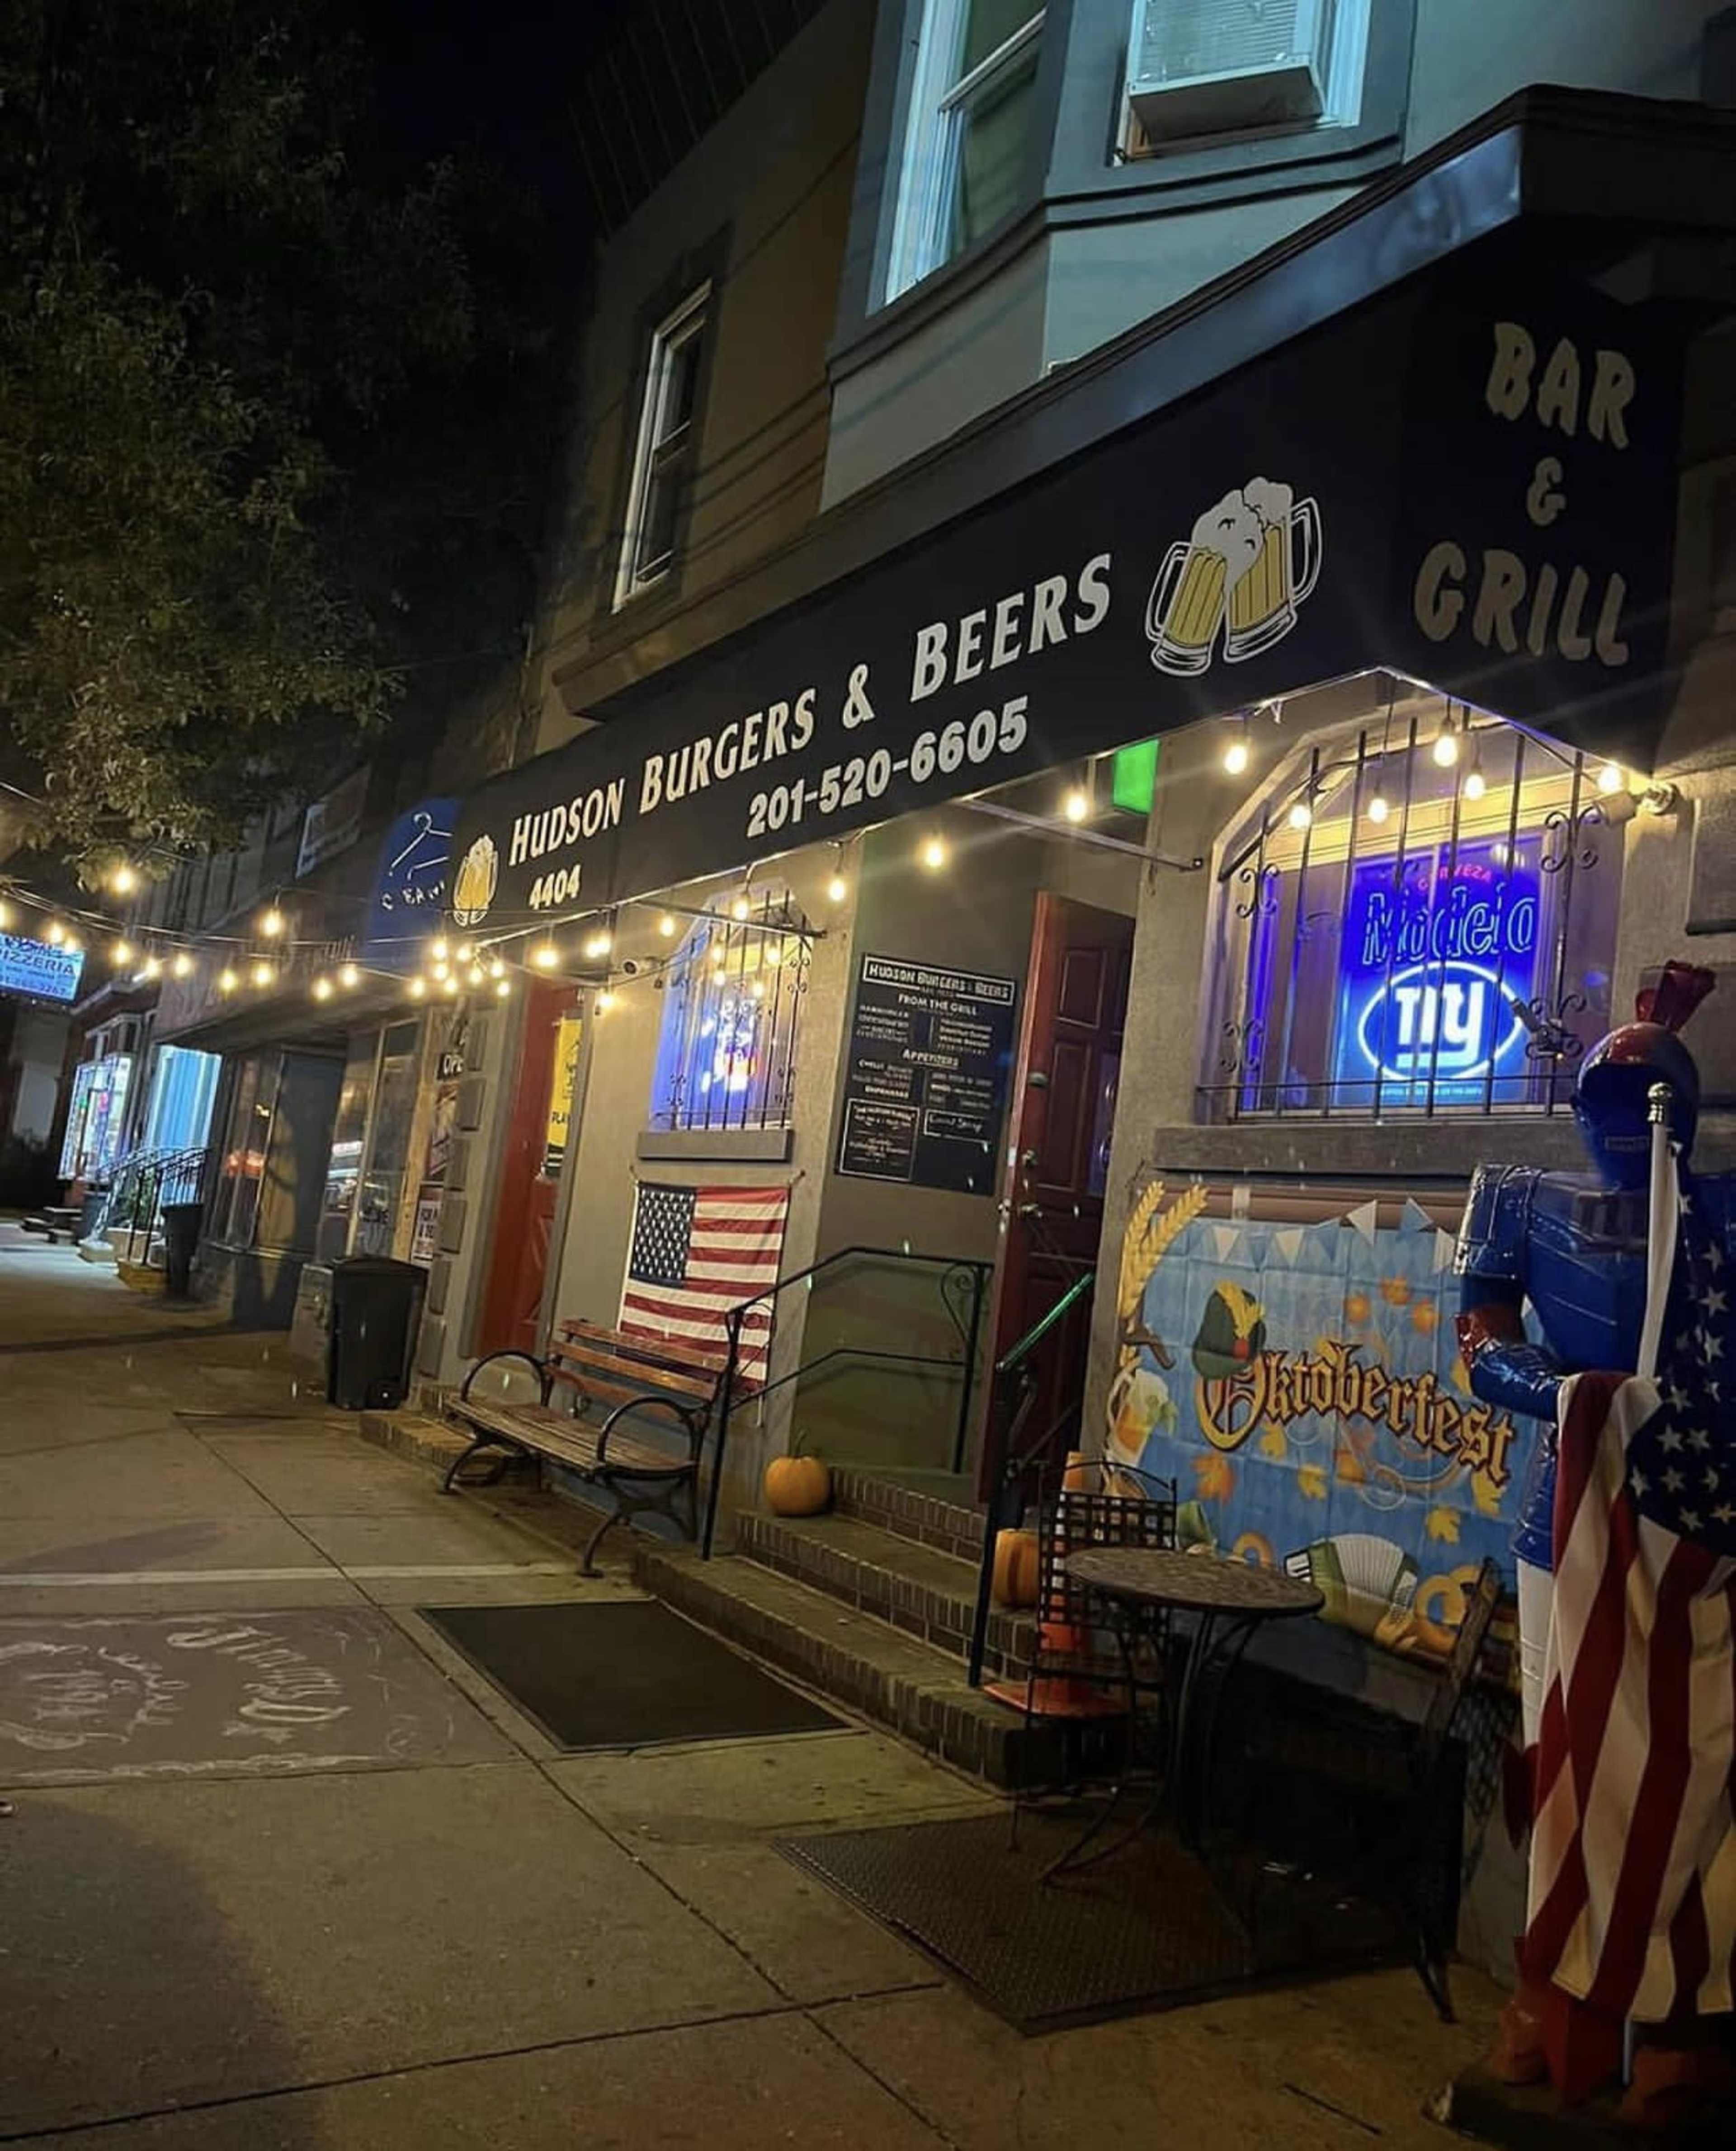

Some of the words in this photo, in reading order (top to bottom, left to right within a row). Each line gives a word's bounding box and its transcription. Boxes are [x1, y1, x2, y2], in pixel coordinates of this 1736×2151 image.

[1486, 322, 1635, 450] BAR
[1527, 457, 1566, 526] &
[1415, 542, 1629, 665] GRILL
[509, 778, 625, 866] HUDSON
[640, 688, 816, 814] BURGERS
[843, 664, 875, 729] &
[910, 553, 1111, 703] BEERS
[747, 695, 1028, 838] 201-520-6605
[529, 864, 581, 910] 4404
[0, 949, 74, 975] IZZERIA
[1195, 1340, 1514, 1484] Oktoberfest
